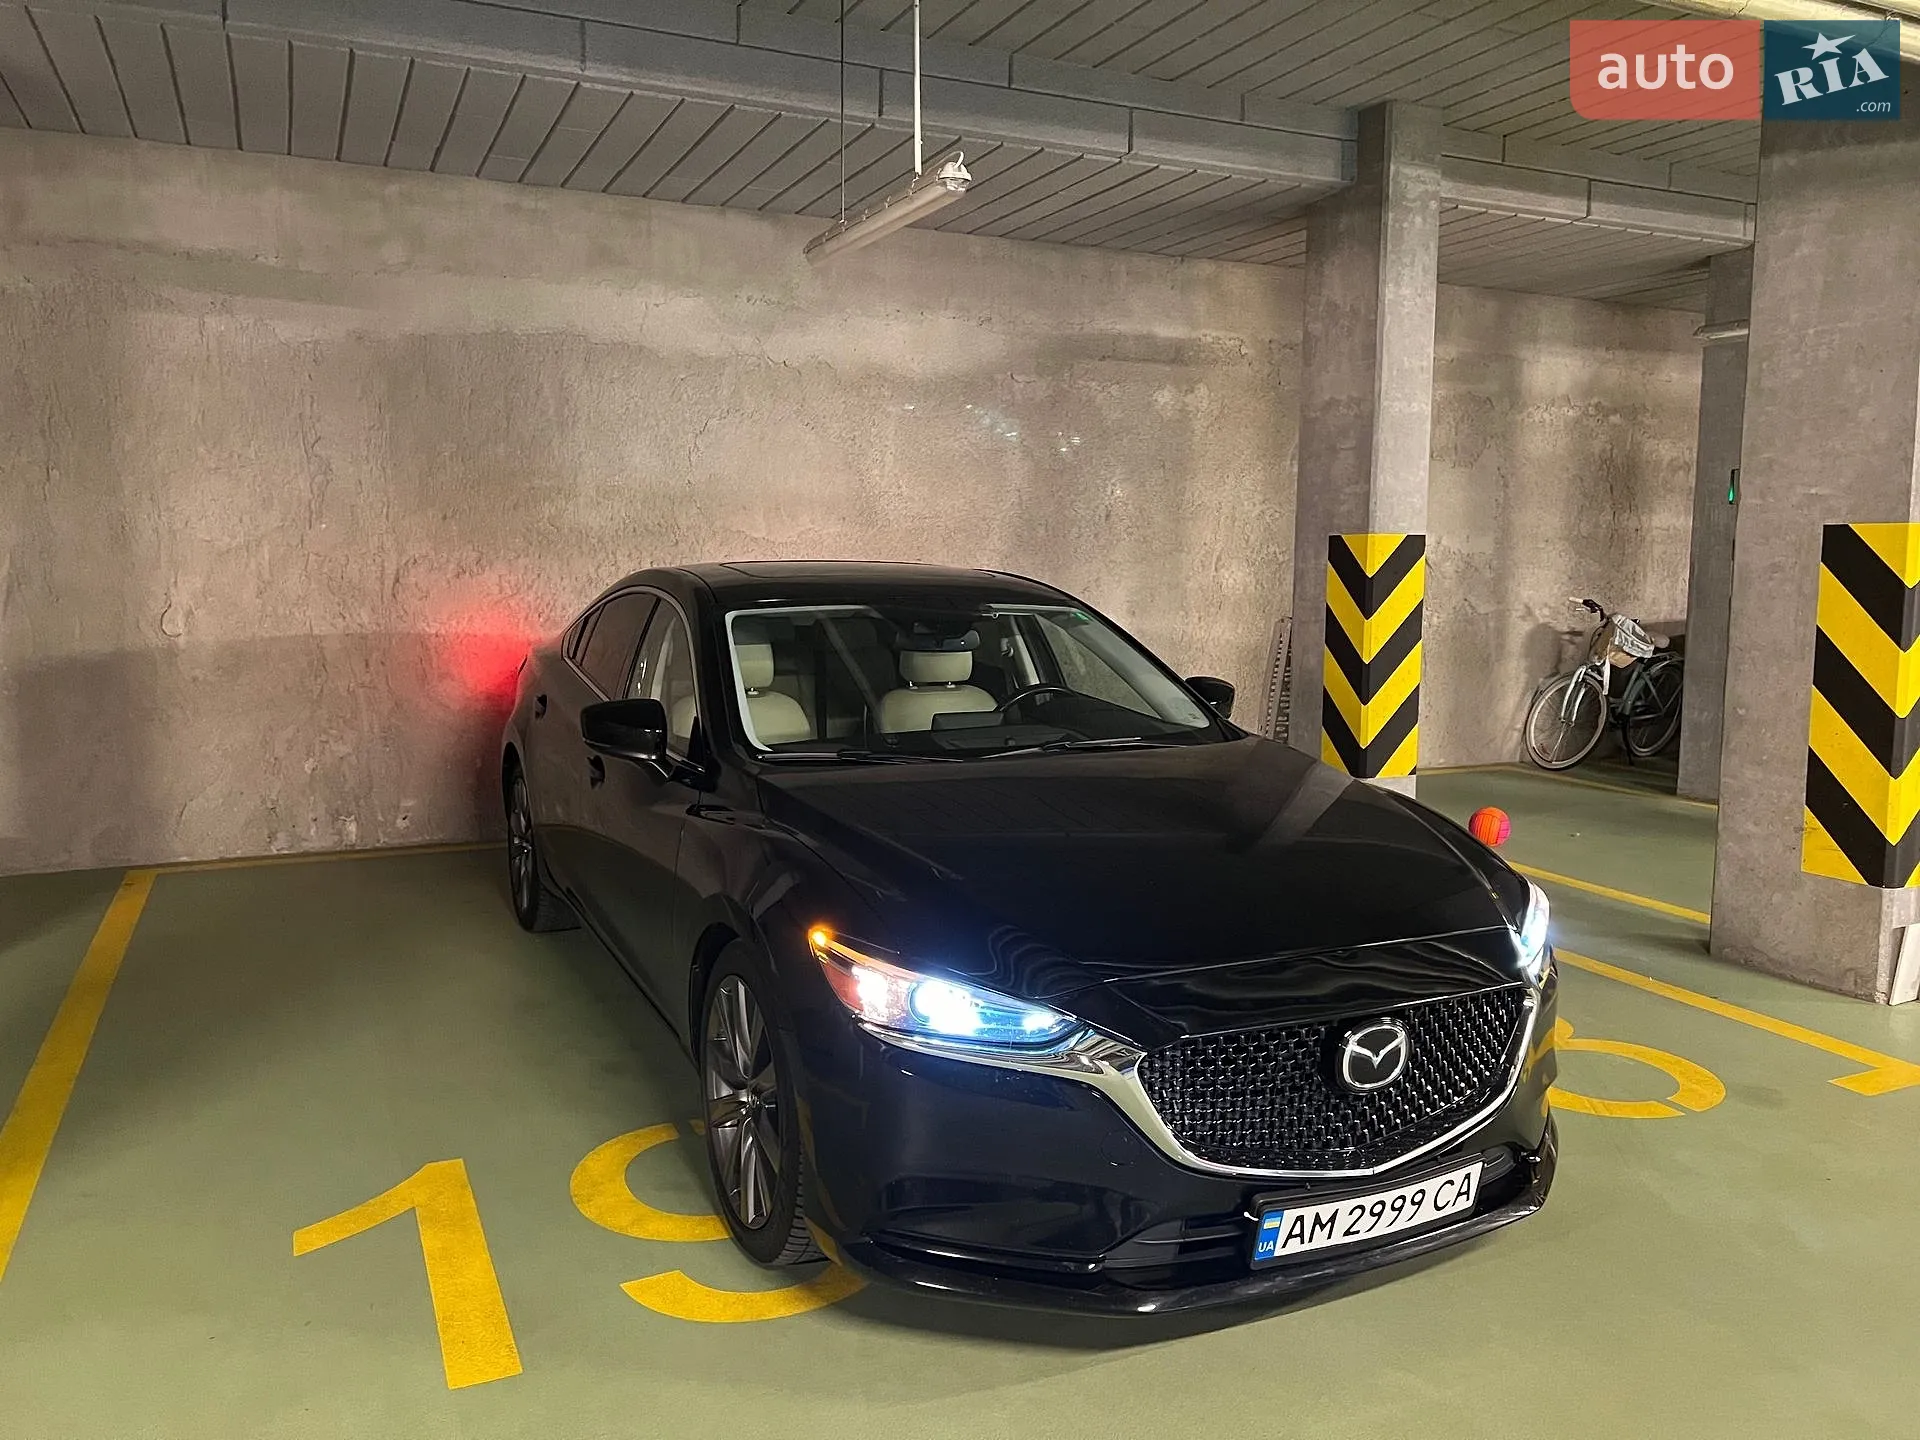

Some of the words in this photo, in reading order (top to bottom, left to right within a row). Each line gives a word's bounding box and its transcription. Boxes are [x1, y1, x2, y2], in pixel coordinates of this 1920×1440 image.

[1280, 1208, 1339, 1249] AM
[1342, 1188, 1426, 1237] 2999
[1433, 1172, 1472, 1212] CA
[1257, 1240, 1275, 1254] UA
